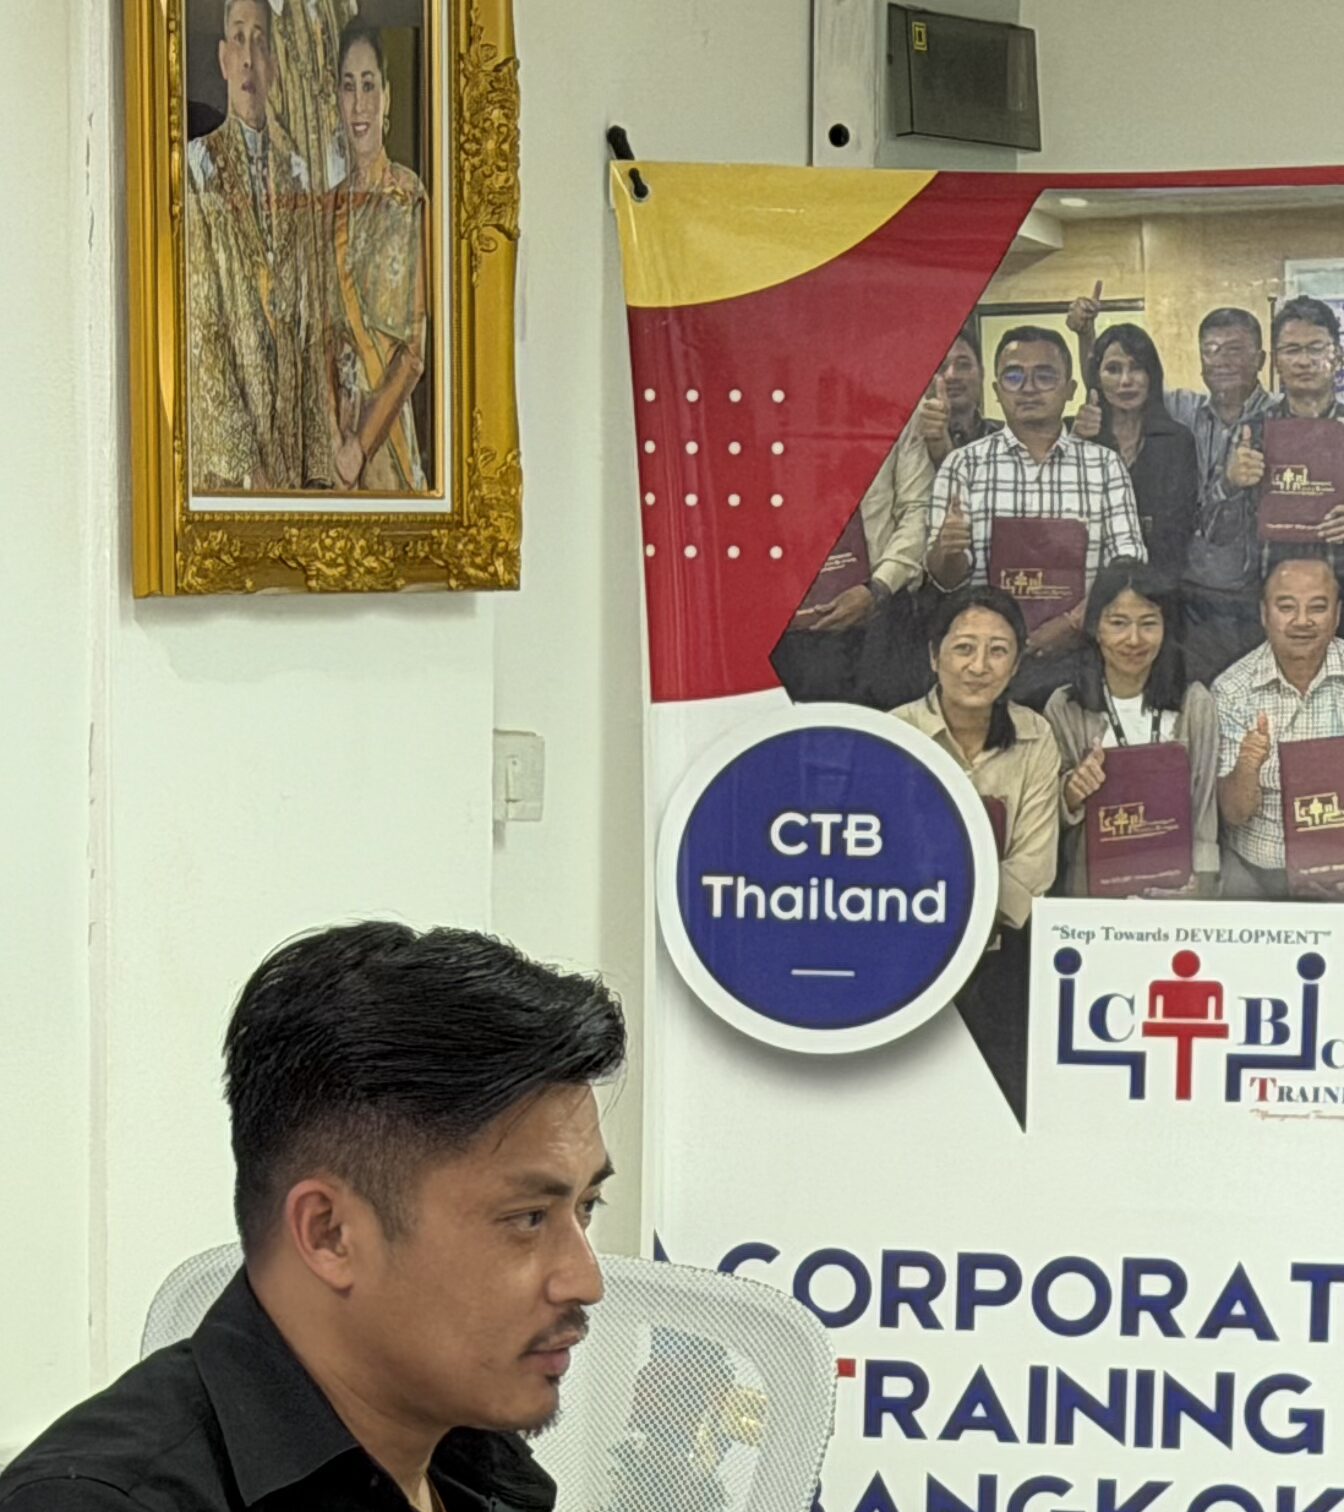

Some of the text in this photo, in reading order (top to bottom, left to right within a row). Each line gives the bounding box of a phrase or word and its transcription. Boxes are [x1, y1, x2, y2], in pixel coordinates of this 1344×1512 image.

[769, 811, 883, 858] CTB
[701, 874, 948, 925] Thailand
[1100, 926, 1170, 944] Towards
[836, 1357, 1326, 1455] RAINING
